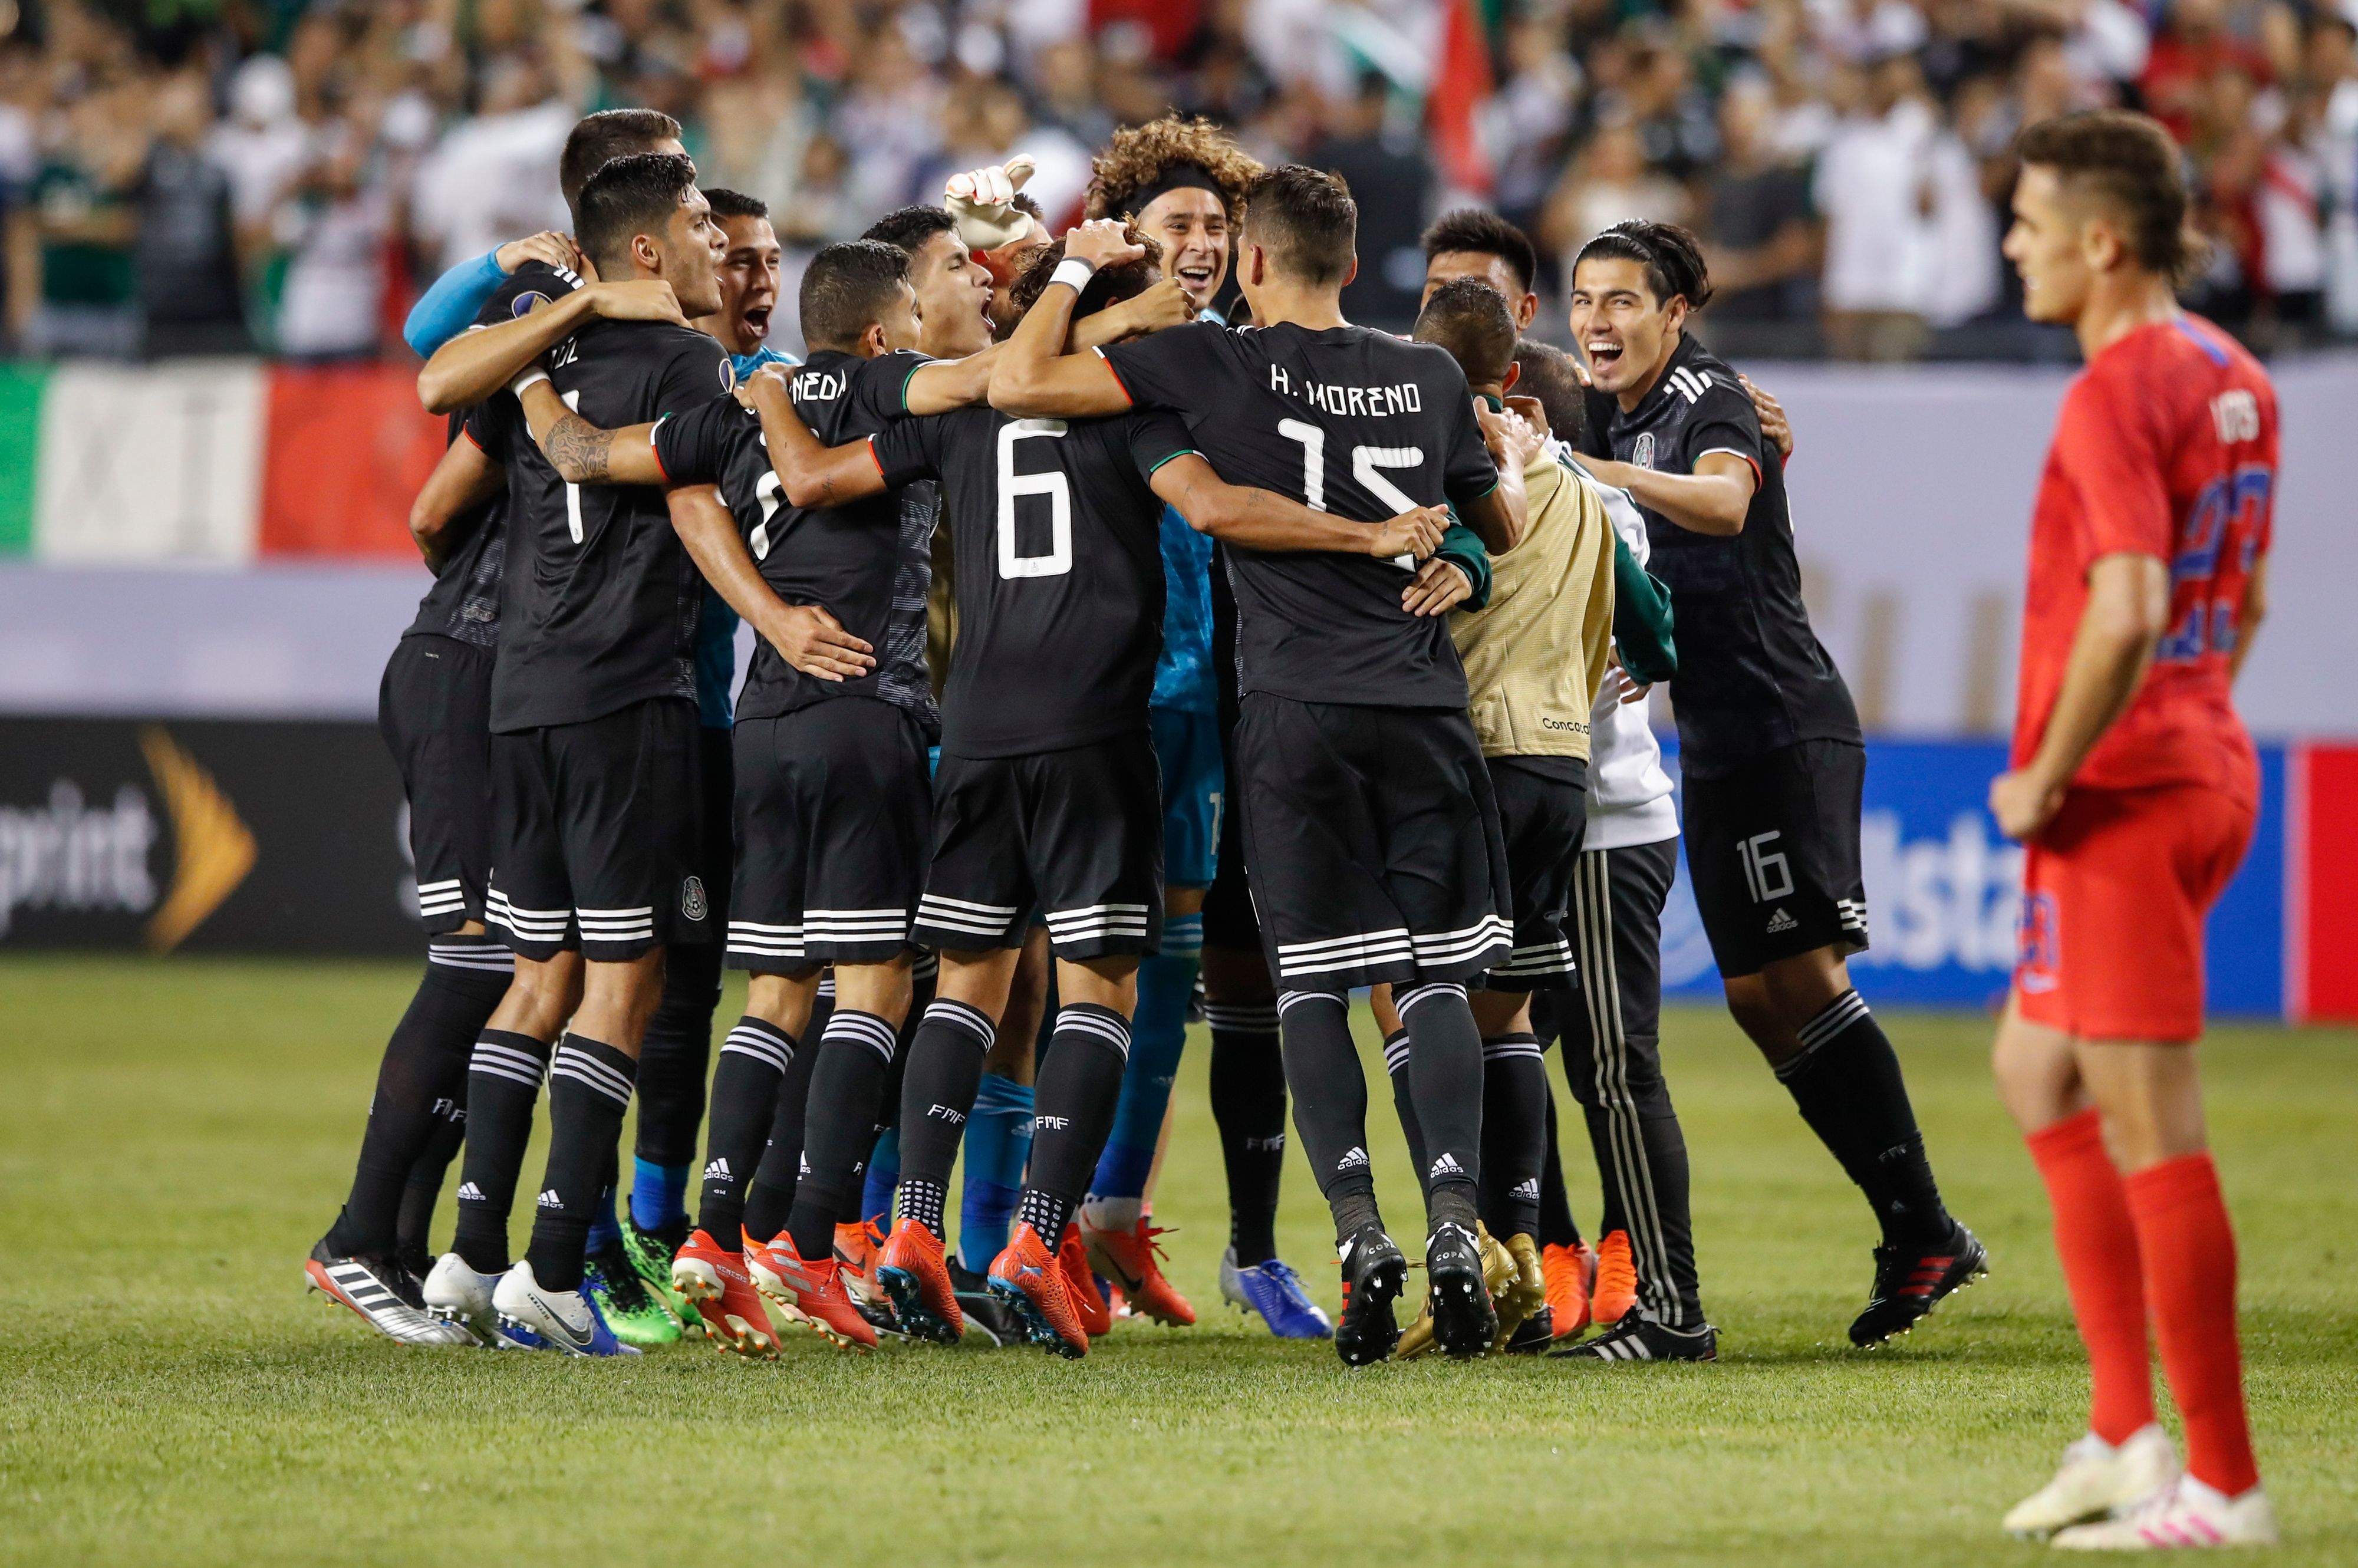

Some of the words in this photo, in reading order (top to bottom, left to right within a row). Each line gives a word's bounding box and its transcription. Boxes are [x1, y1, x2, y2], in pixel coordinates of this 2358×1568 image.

[789, 368, 847, 405] NEDA
[1271, 364, 1298, 397] H.
[1305, 380, 1421, 417] MORENO
[997, 419, 1073, 580] 6
[1736, 830, 1795, 904] 16
[1766, 920, 1799, 934] adidas
[927, 1103, 966, 1125] FMF
[1035, 1116, 1069, 1131] FMF
[1430, 1164, 1464, 1179] adidas
[1509, 1190, 1540, 1200] adidas
[1368, 1242, 1397, 1255] COPA
[1435, 1251, 1465, 1262] COPA
